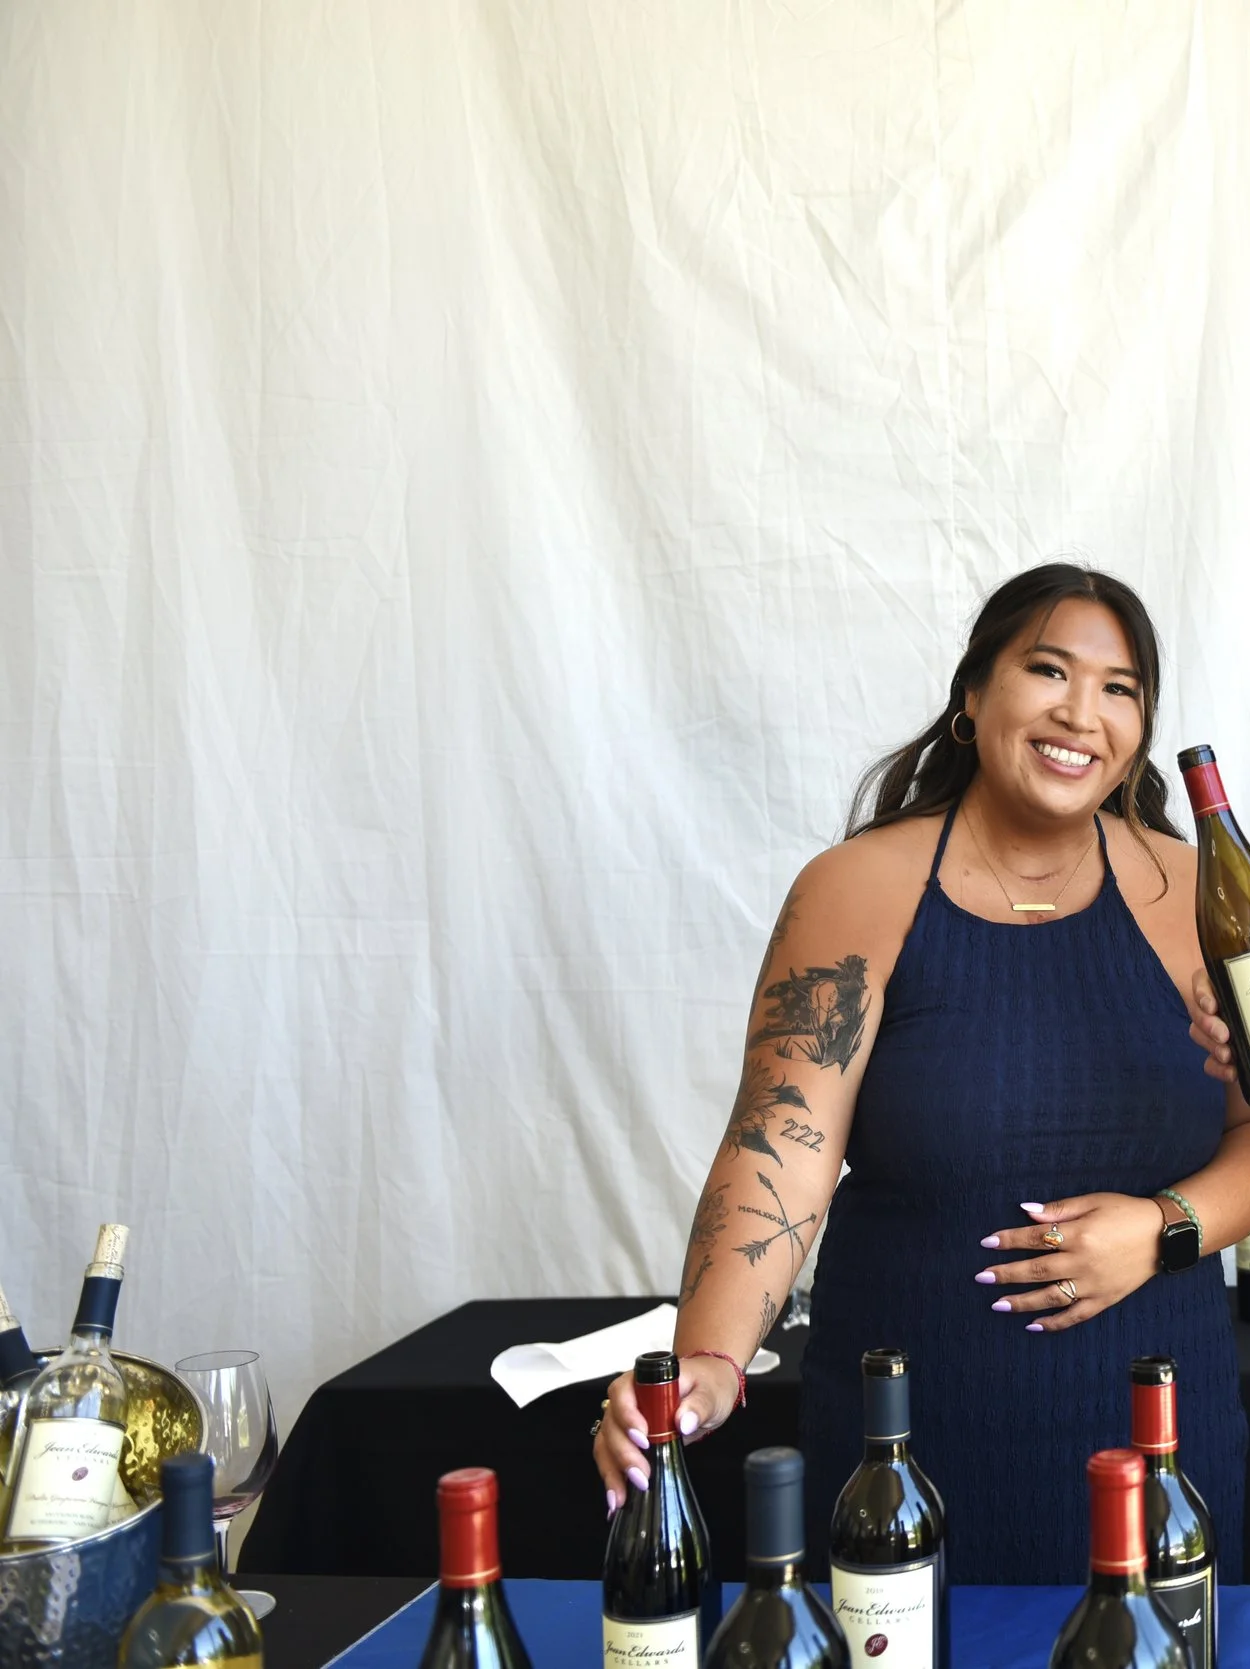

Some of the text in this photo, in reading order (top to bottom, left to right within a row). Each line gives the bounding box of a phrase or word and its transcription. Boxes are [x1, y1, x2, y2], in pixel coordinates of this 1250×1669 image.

[780, 1118, 825, 1152] 222
[833, 1595, 926, 1616] Jean Edwards
[603, 1640, 686, 1658] Jean Edwards
[614, 1657, 669, 1667] CELLARS
